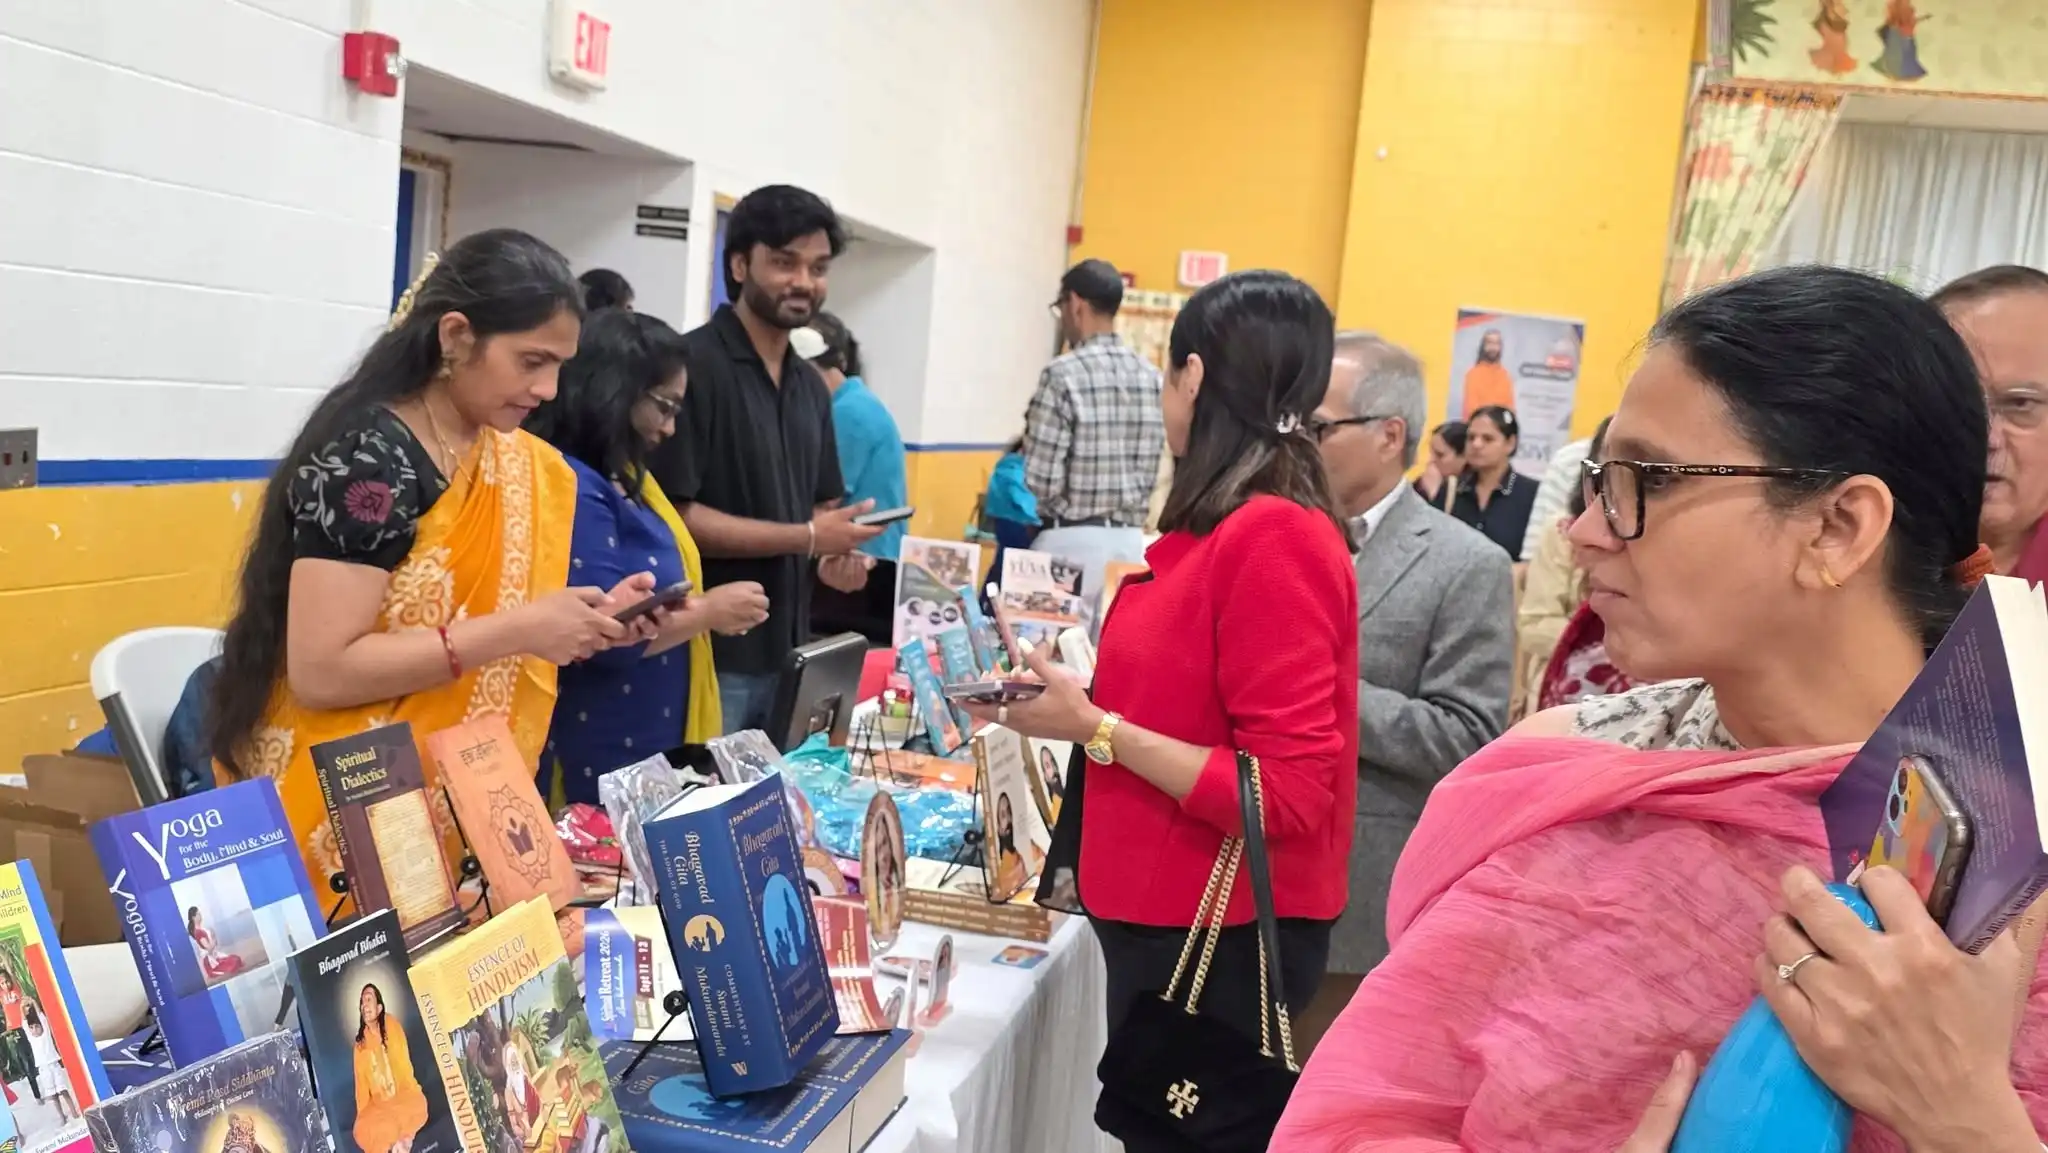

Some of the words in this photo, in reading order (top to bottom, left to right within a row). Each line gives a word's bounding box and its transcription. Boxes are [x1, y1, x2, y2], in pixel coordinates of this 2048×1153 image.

[335, 746, 377, 772] Spiritual
[340, 767, 388, 791] Dialectics
[318, 768, 337, 812] Spiritual
[132, 808, 224, 880] Yoga
[178, 843, 194, 855] for
[193, 839, 209, 852] the
[182, 853, 219, 870] Body,
[218, 840, 248, 858] Mind
[247, 836, 260, 848] &
[259, 828, 285, 846] Soul
[330, 811, 348, 856] Dialectics
[672, 854, 690, 887] Gita
[684, 830, 716, 905] Bhagavad
[0, 905, 29, 919] ildren
[108, 868, 147, 936] Yoga
[317, 941, 360, 977] Bhagavad
[359, 930, 388, 955] Bhakti
[467, 942, 511, 983] ESSENCE
[599, 929, 612, 956] 2026
[466, 946, 541, 1013] HINDUISM
[598, 957, 612, 996] Retreat
[639, 975, 653, 993] Sept
[723, 963, 747, 1031] COMMENTARY
[420, 993, 449, 1049] ESSENCE
[715, 989, 735, 1030] Swami
[439, 1052, 455, 1071] OF
[446, 1074, 485, 1153] HINDUI
